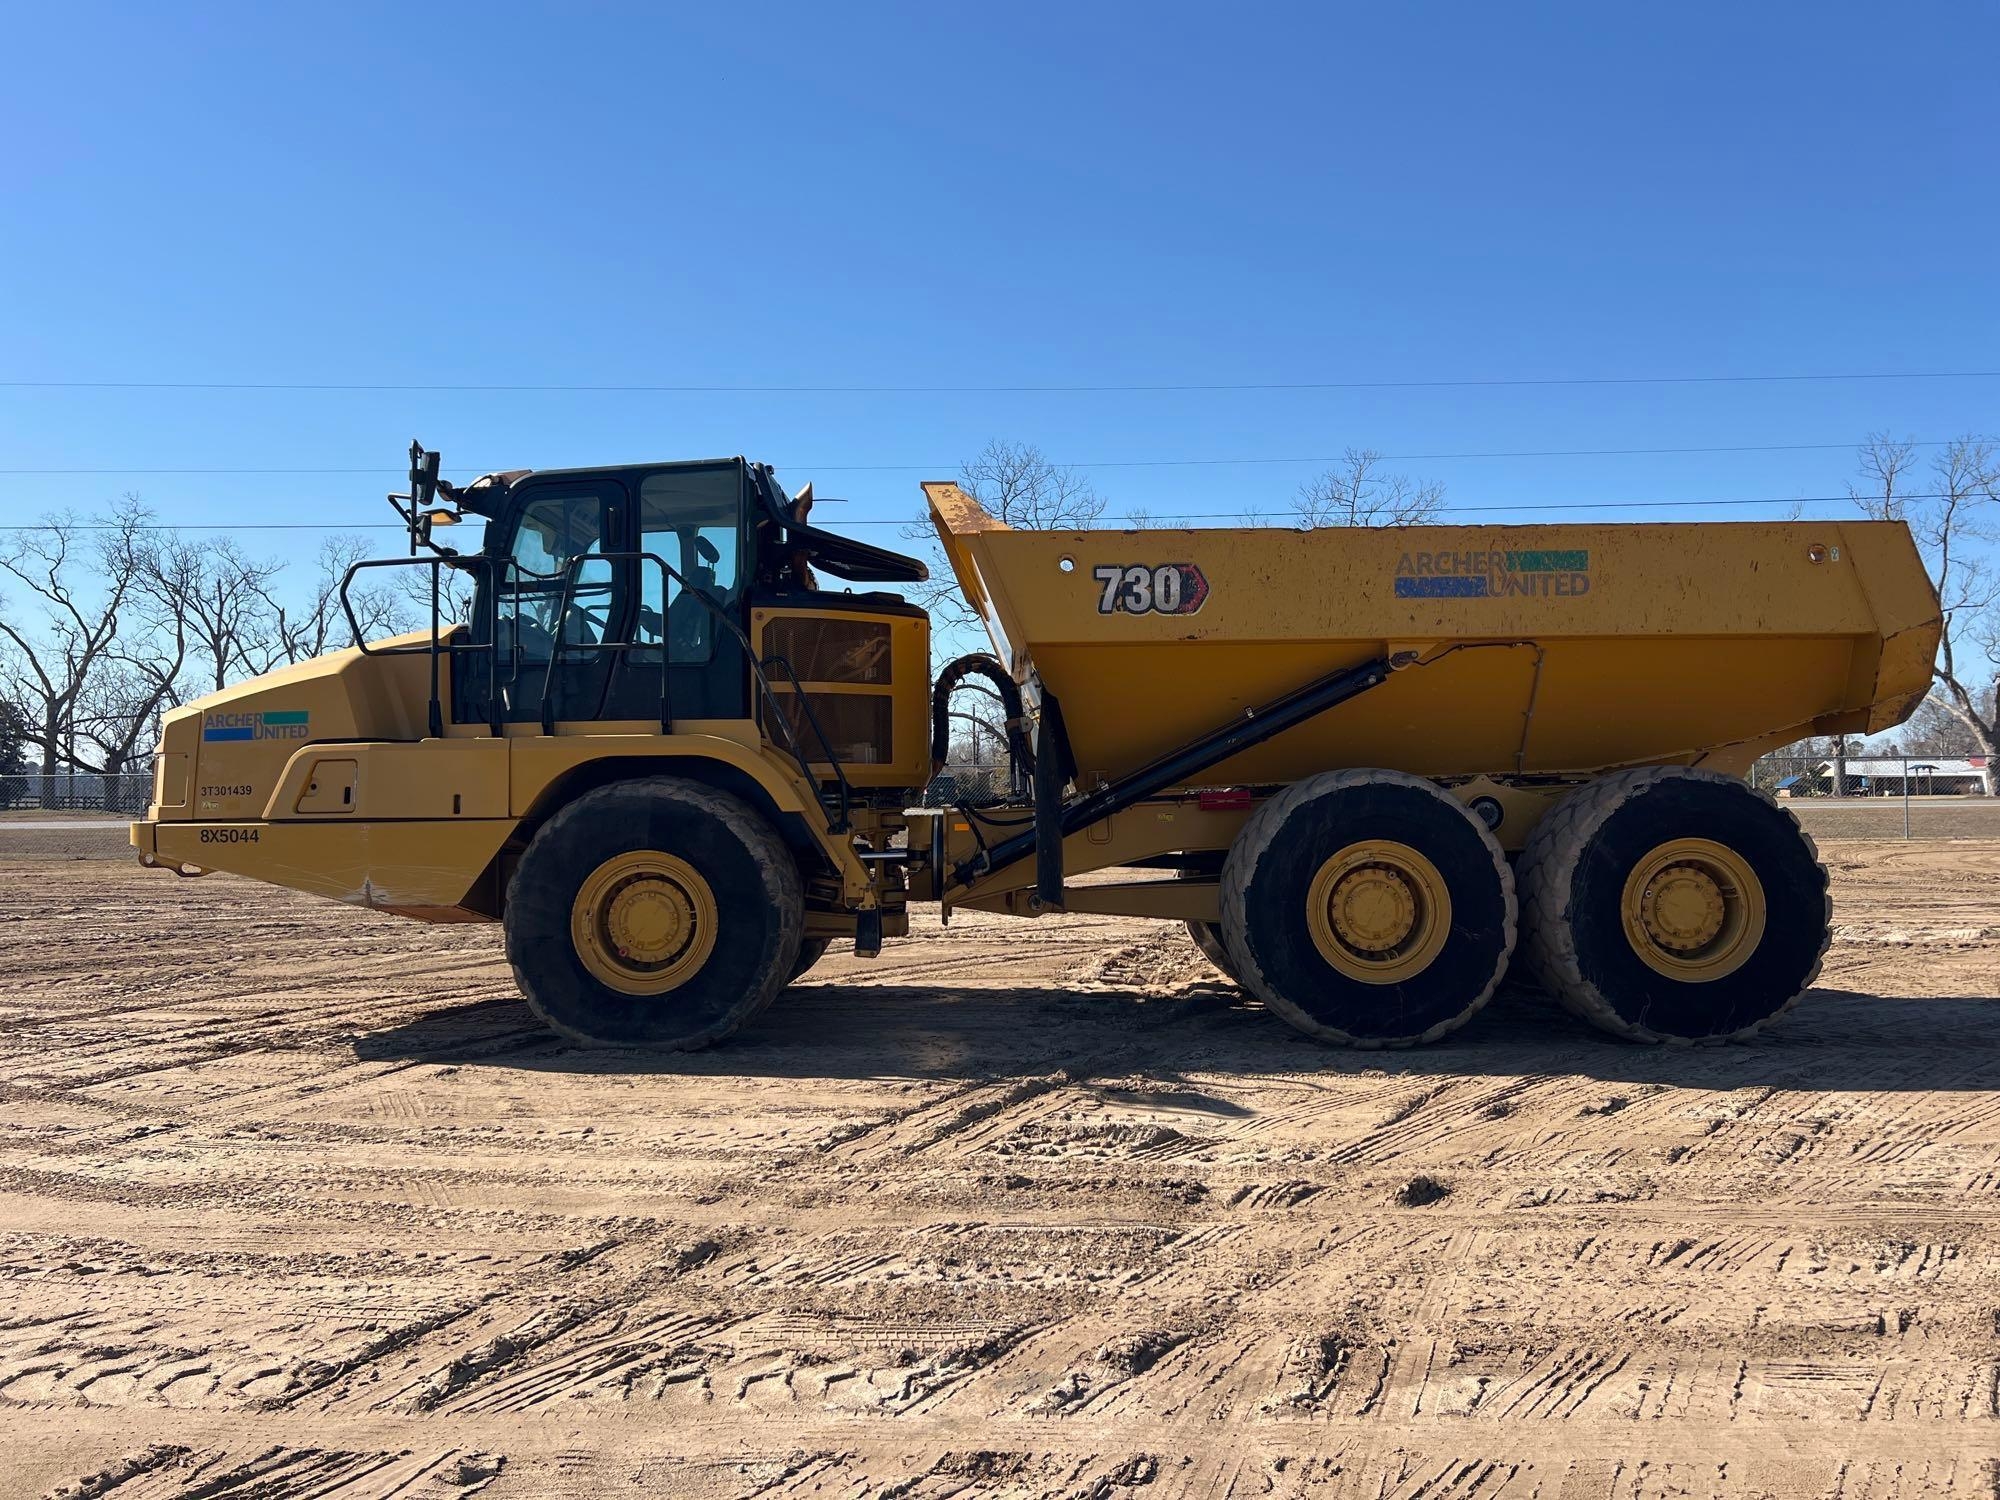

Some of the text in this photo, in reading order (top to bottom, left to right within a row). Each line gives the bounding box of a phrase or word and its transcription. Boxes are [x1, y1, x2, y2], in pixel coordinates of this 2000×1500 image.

[1395, 551, 1507, 576] ARCHER
[1095, 566, 1182, 612] 730
[1487, 571, 1591, 598] UNITED
[204, 712, 263, 729] ARCHER
[253, 724, 309, 740] UNITED
[200, 785, 253, 797] 3T301439
[200, 829, 260, 844] 8X5044
